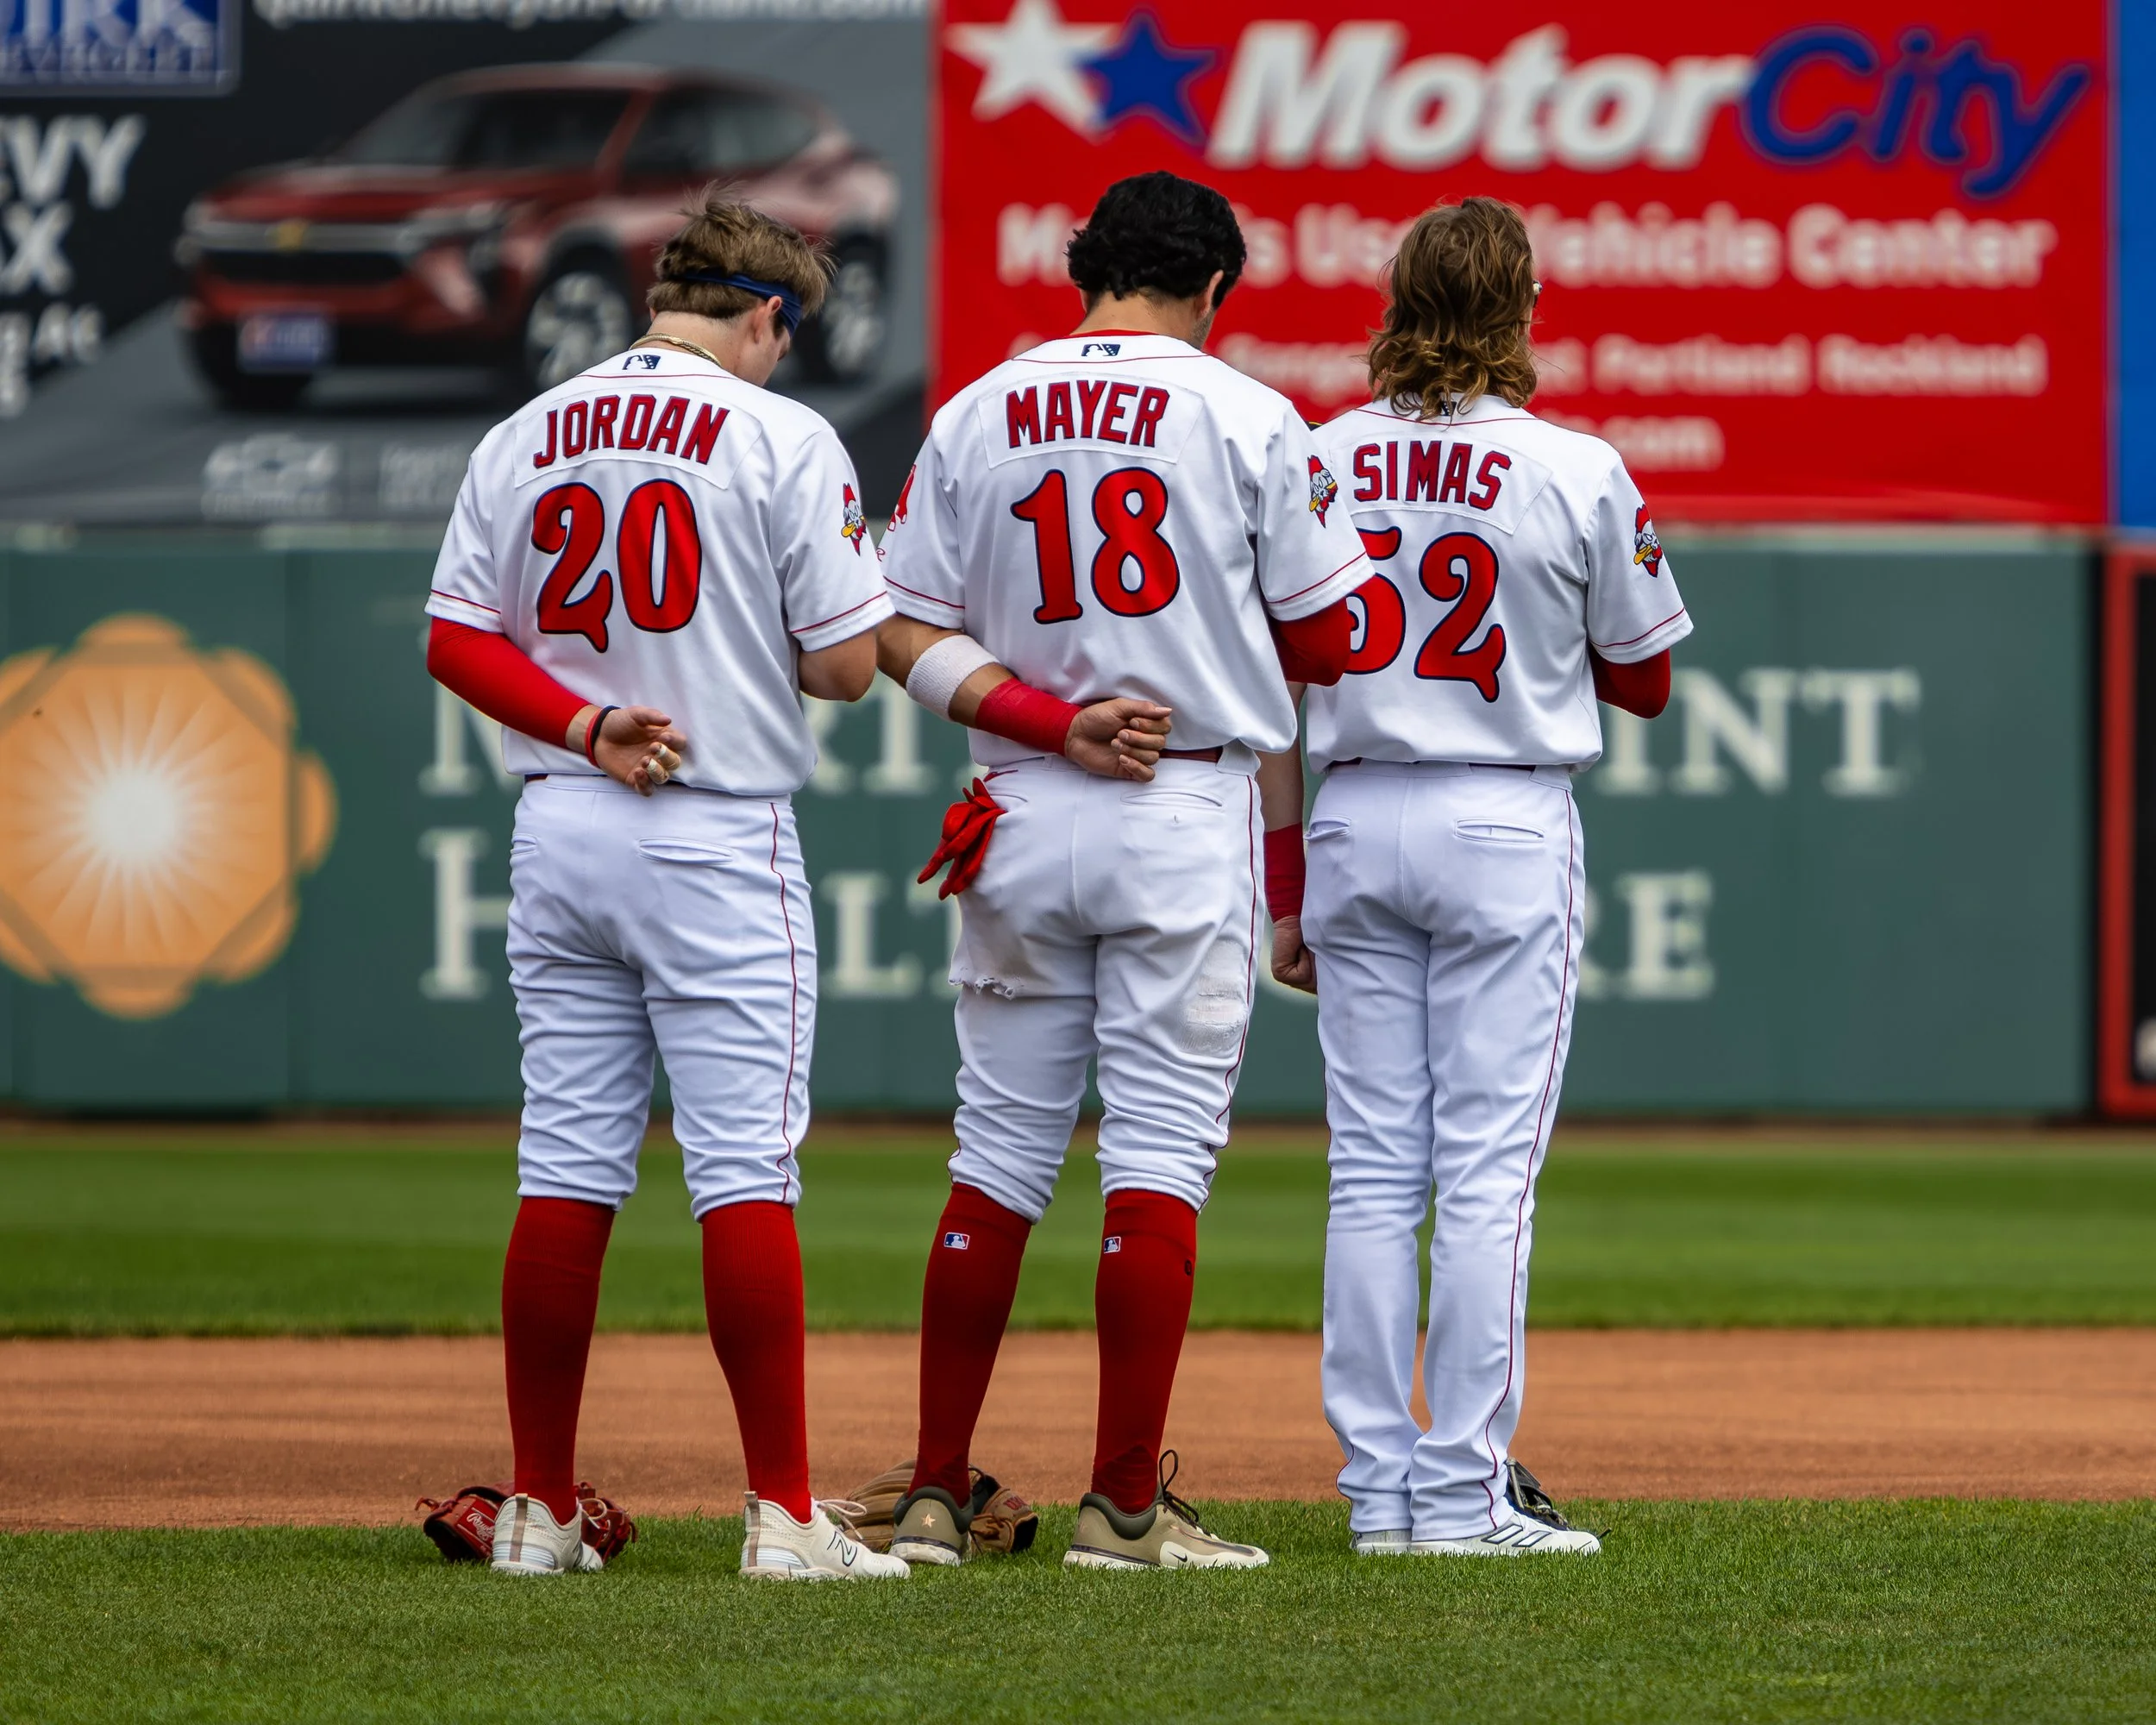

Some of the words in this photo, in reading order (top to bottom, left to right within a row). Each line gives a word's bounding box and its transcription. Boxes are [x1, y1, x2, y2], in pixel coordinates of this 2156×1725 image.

[1788, 204, 2059, 289] Center
[533, 393, 730, 469] JORDAN
[1005, 380, 1170, 448] MAYER
[1352, 440, 1513, 511] SIMAS
[531, 478, 703, 654] 20
[1010, 467, 1181, 625] 18
[1344, 525, 1507, 704] 52
[1595, 668, 1921, 795] INT
